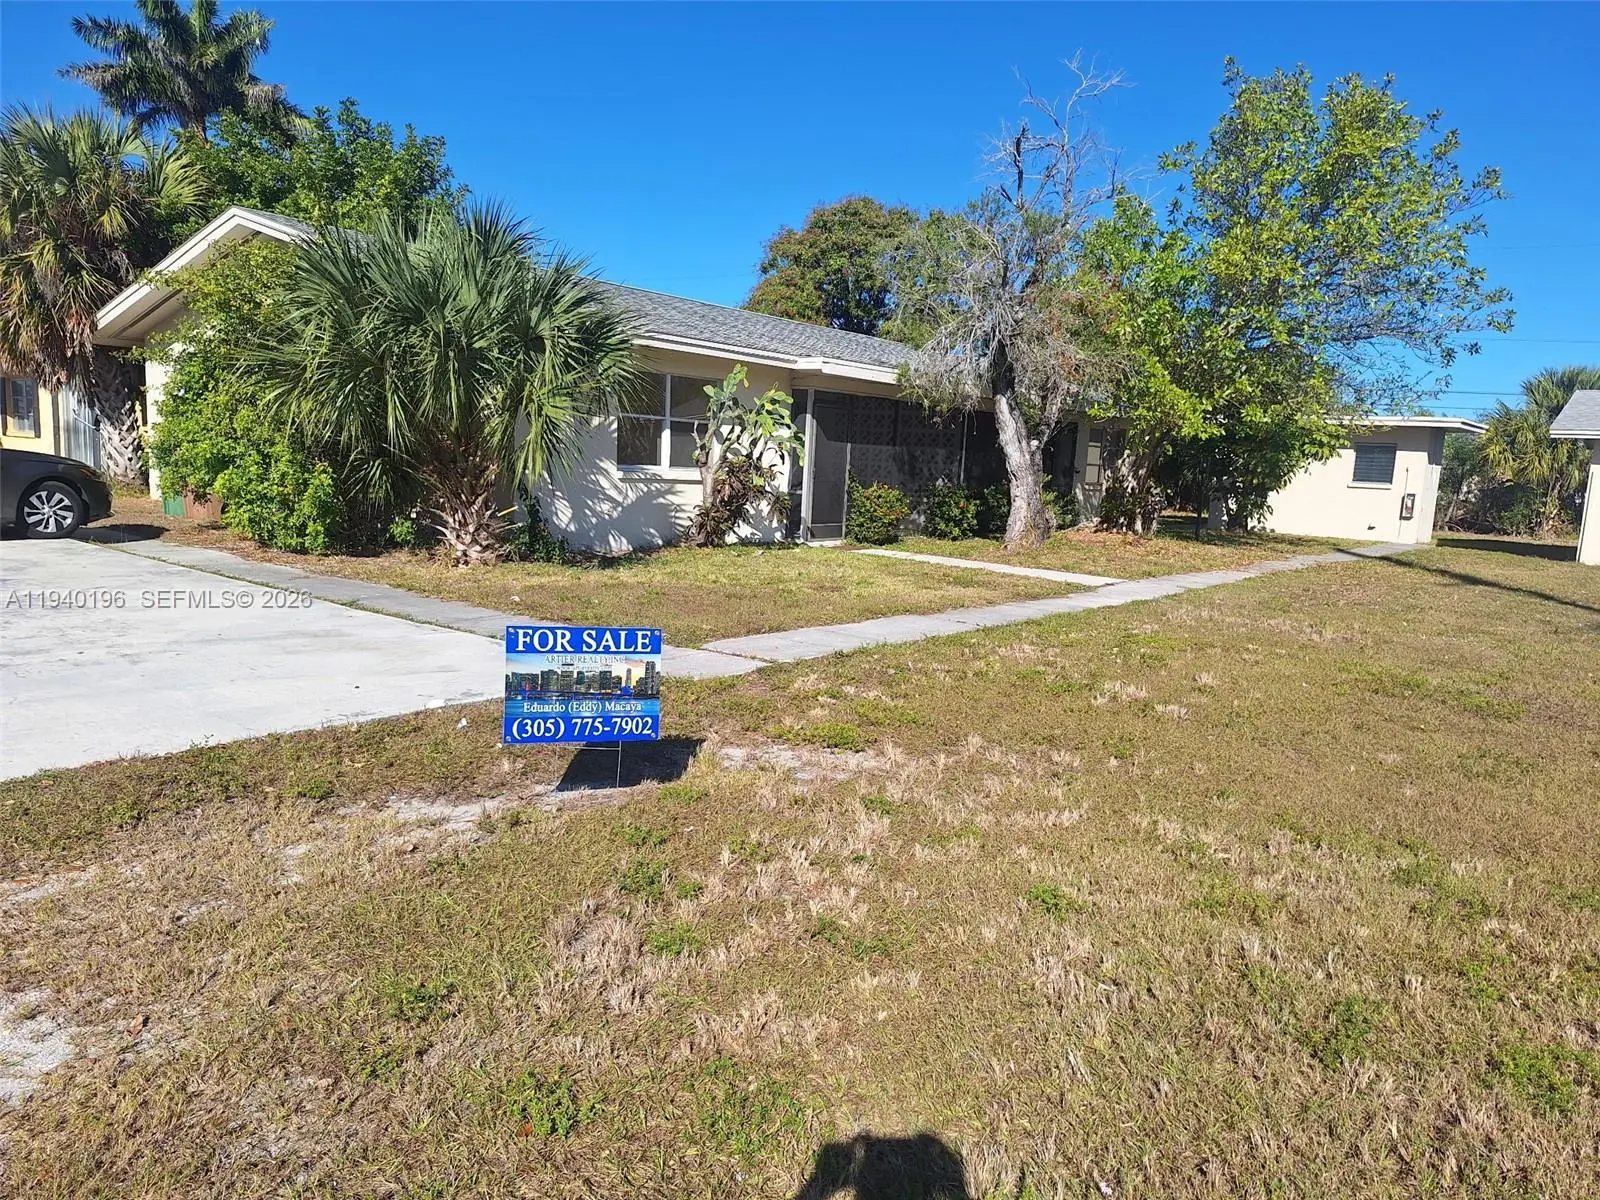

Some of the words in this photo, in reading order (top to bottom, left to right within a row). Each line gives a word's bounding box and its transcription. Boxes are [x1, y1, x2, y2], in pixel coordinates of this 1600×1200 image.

[516, 629, 574, 651] FOR
[583, 630, 651, 652] SALE
[523, 702, 565, 712] Eduardo
[569, 702, 602, 713] (Eddy)
[605, 703, 641, 713] Macaya
[513, 718, 565, 739] (305)
[572, 717, 652, 735] 775-7902
